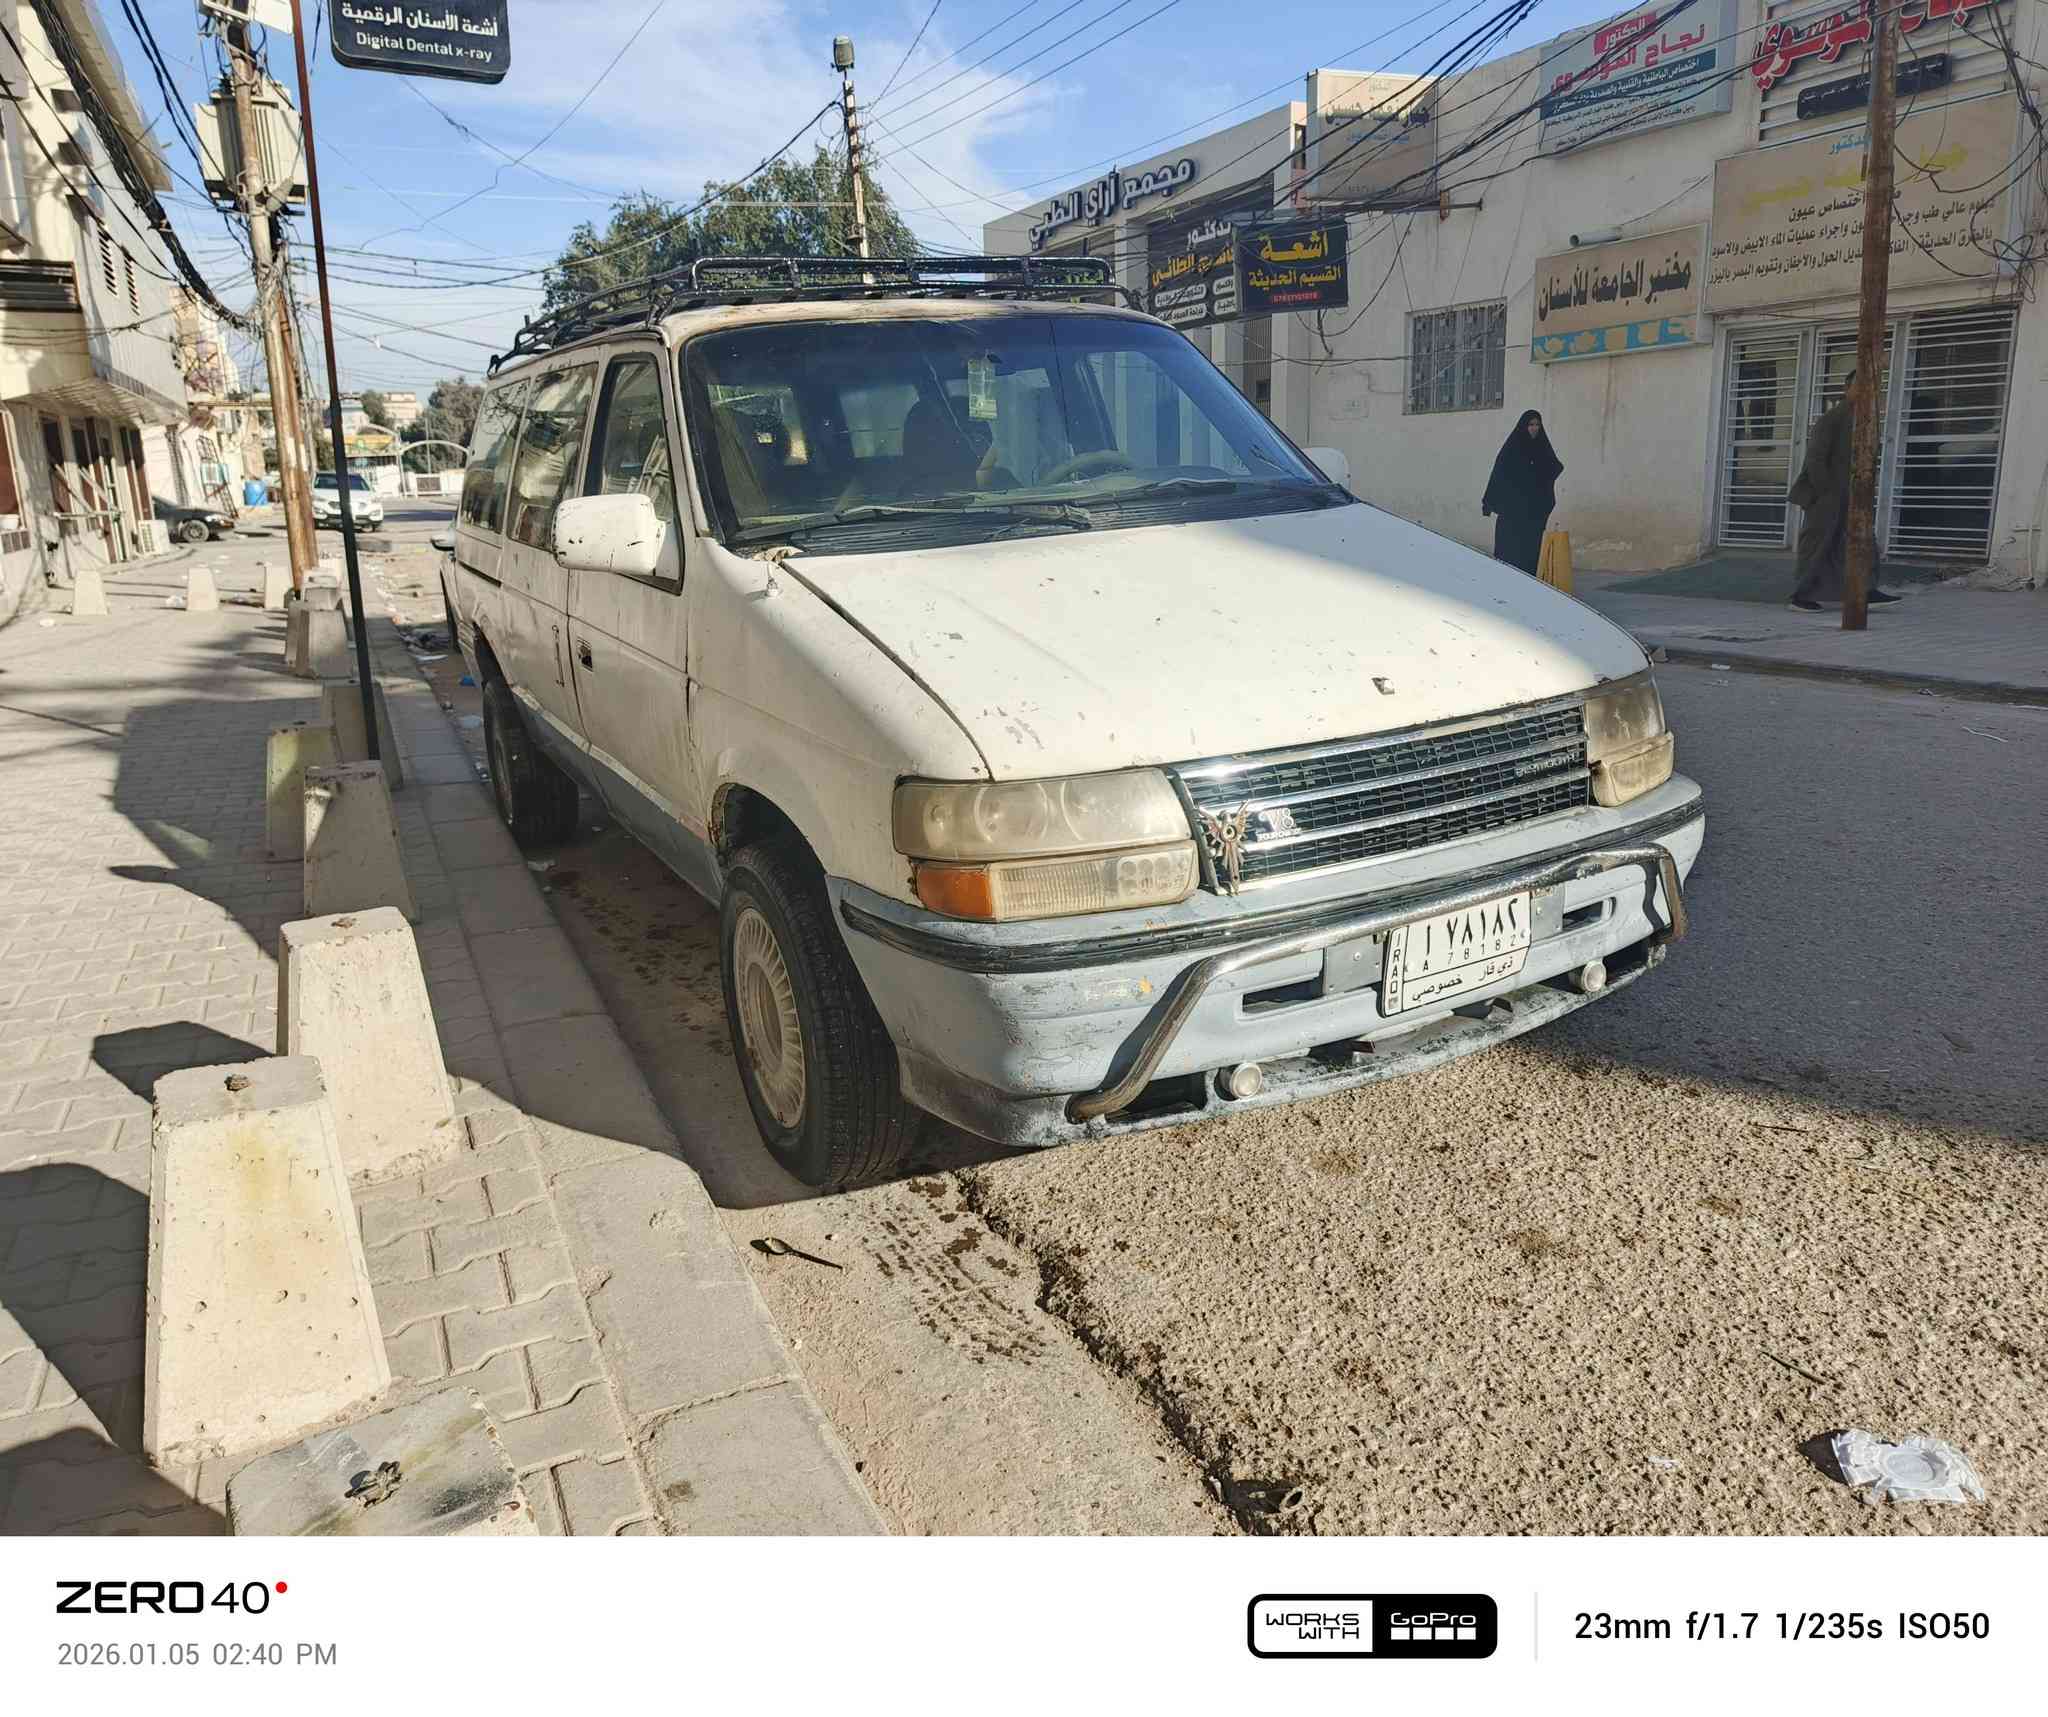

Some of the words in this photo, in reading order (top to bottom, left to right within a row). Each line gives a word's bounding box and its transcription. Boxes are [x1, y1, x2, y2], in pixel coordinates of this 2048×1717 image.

[342, 3, 403, 26] الرقمية
[406, 9, 459, 32] الأسنان
[462, 17, 499, 37] أشعة
[356, 32, 403, 49] Digital
[406, 38, 453, 56] Dental
[455, 47, 493, 62] x-ray
[1645, 24, 1705, 68] نجاح
[1123, 159, 1195, 209] مجمع
[1029, 191, 1083, 250] الطبي
[1788, 206, 1816, 223] عيون
[1922, 205, 1940, 222] طب
[1942, 201, 1966, 222] عالي
[1591, 258, 1645, 306] الجامعة
[1645, 251, 1692, 305] مختبر
[1389, 933, 1401, 994] IRAQ
[1412, 975, 1463, 1001] خصوصي
